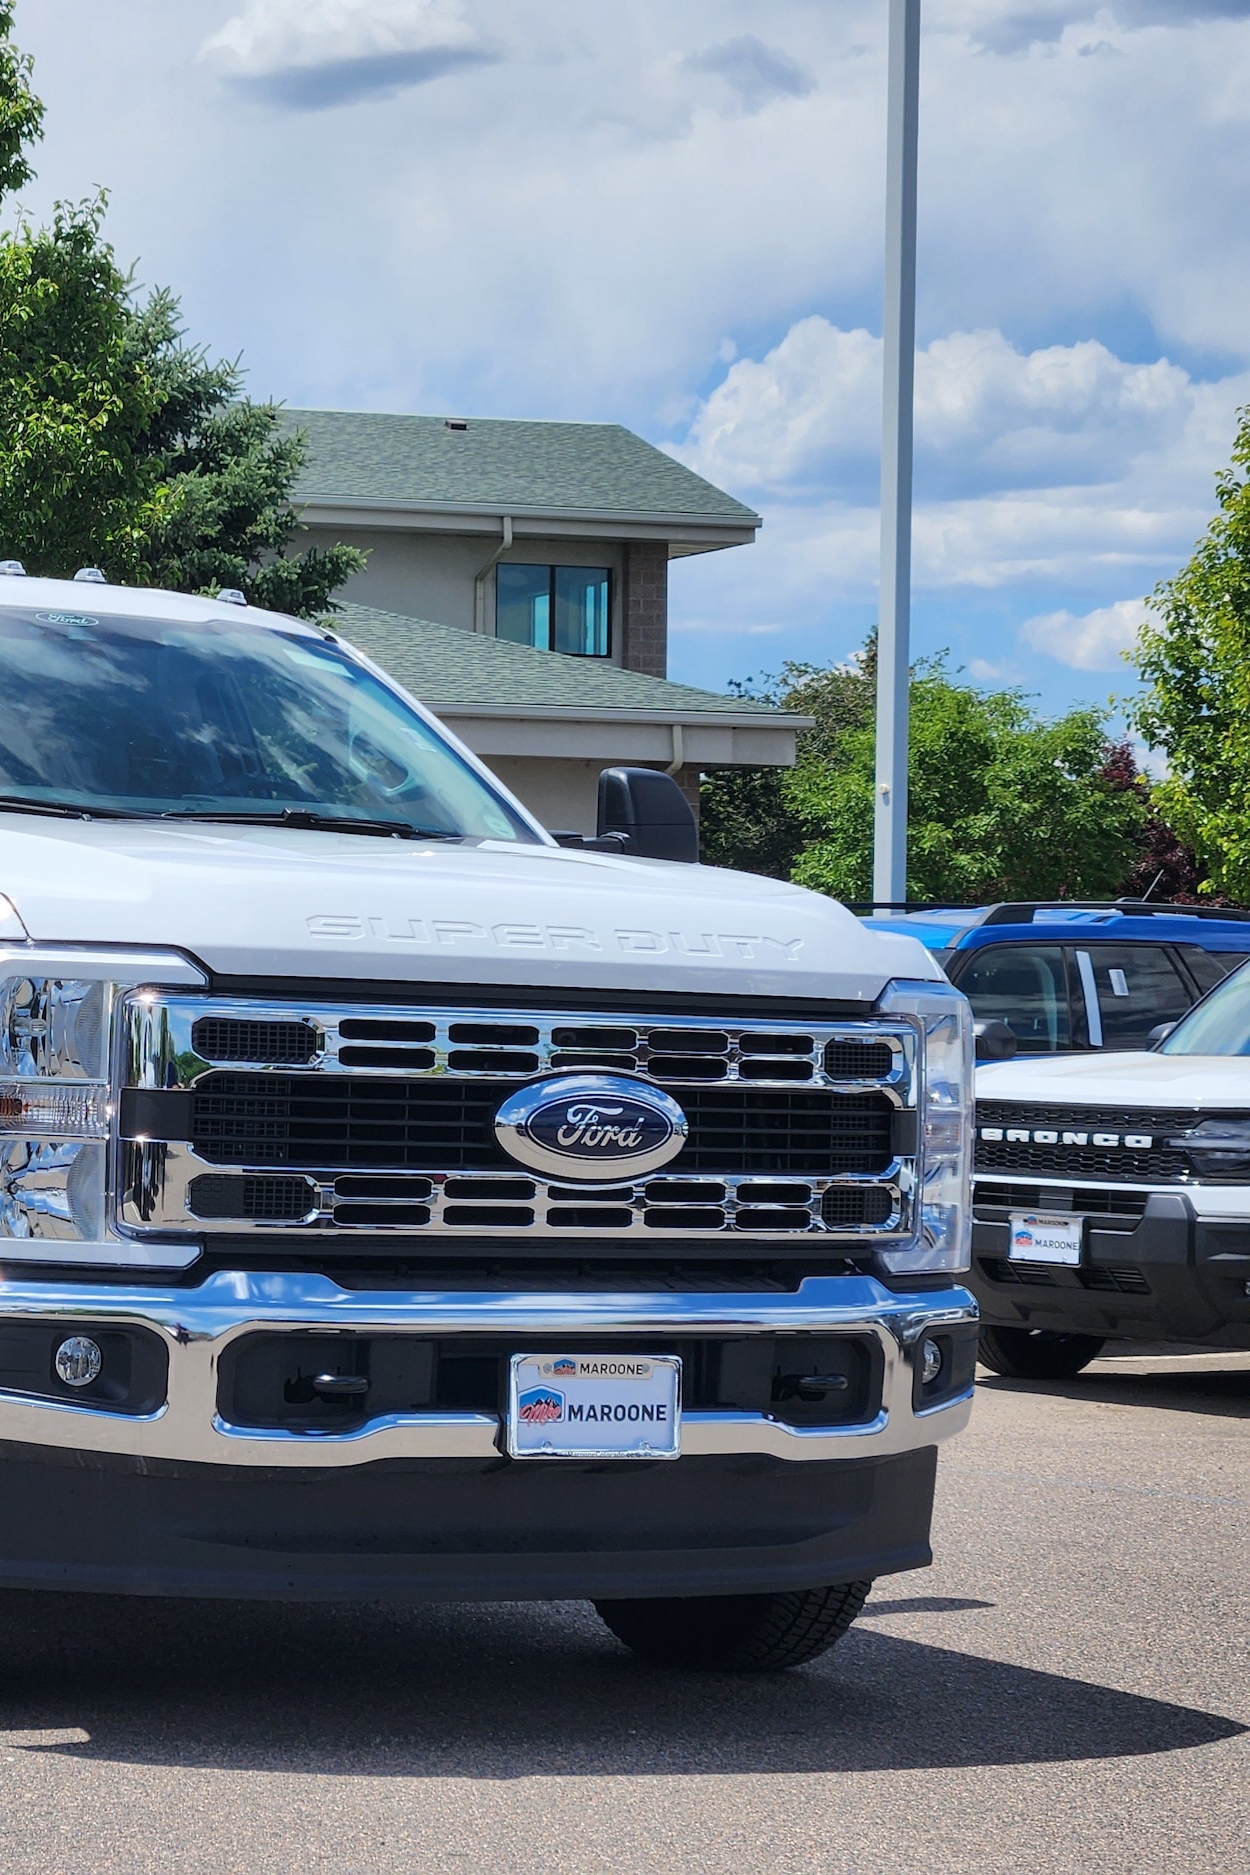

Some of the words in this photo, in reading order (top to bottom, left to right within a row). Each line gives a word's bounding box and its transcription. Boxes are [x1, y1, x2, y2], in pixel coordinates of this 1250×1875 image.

[48, 614, 88, 624] Ford
[305, 913, 603, 952] SUPER
[614, 928, 805, 962] DUTY
[556, 1104, 646, 1148] Ford
[980, 1127, 1153, 1149] BRONCO
[1034, 1239, 1079, 1251] MAROONE
[579, 1363, 644, 1375] MAROONE
[567, 1403, 668, 1422] MAROONE
